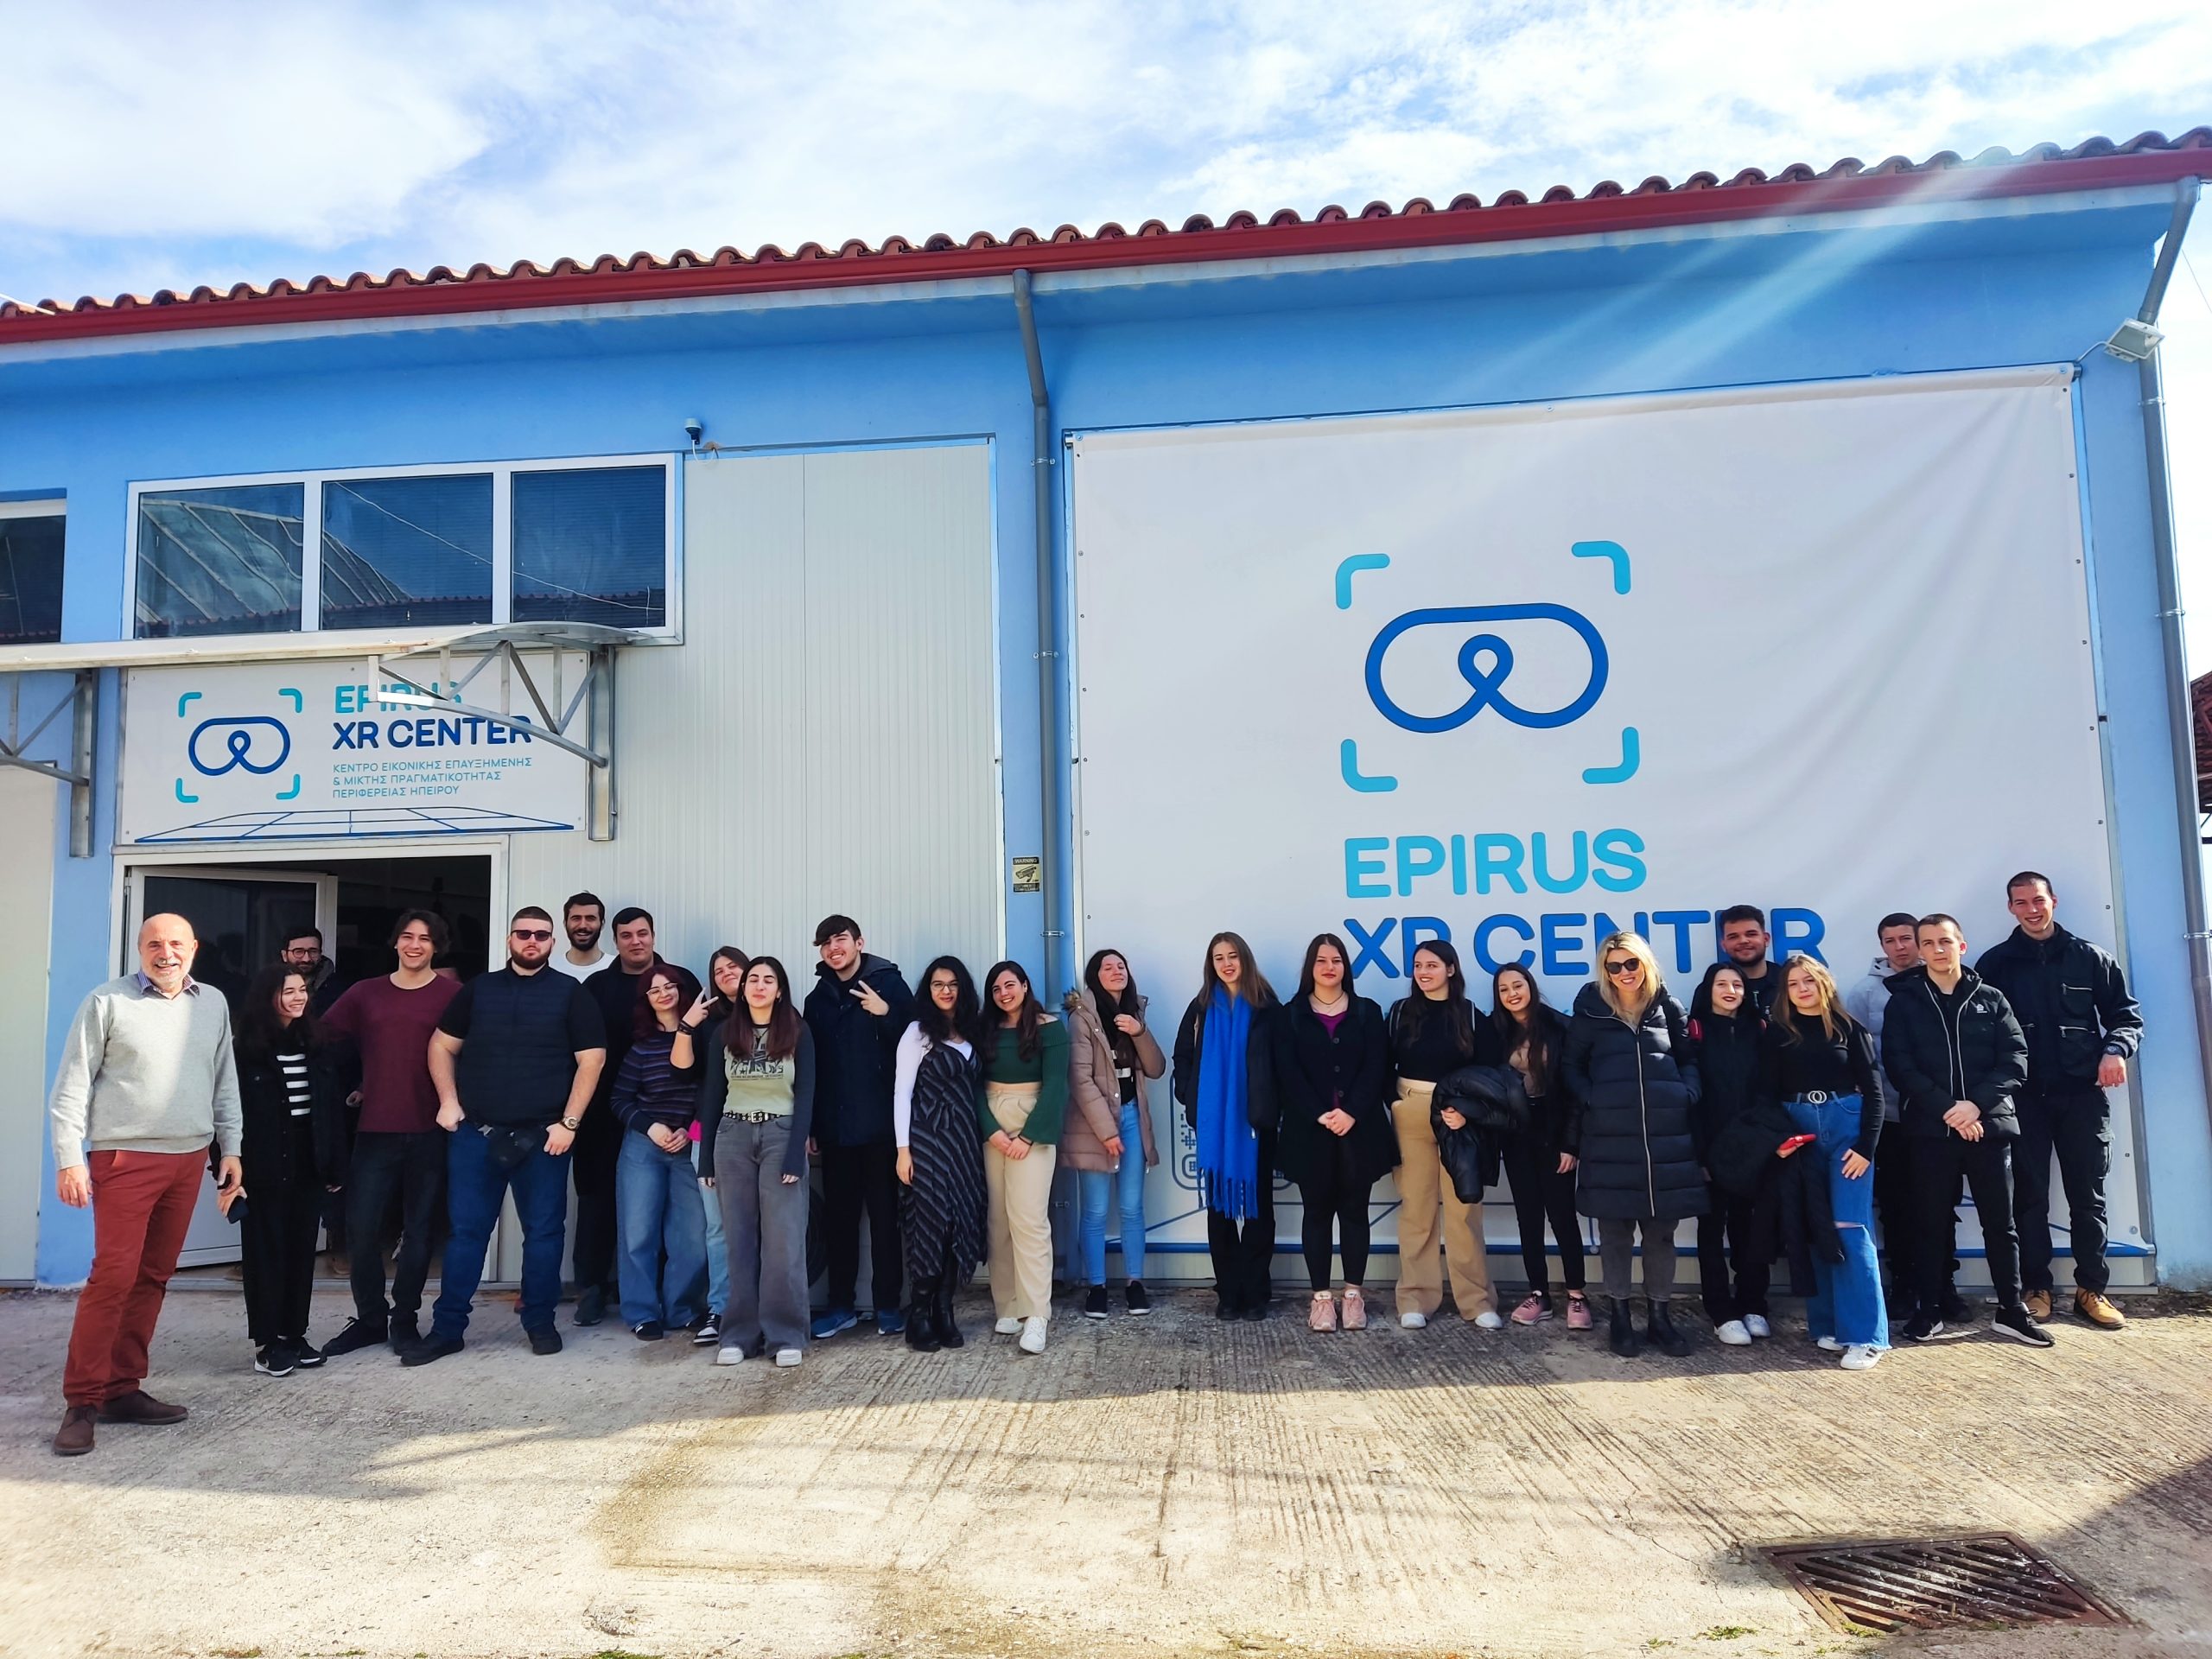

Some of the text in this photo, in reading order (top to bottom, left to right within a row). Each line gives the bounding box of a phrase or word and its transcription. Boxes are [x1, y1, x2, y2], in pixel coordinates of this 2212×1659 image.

[332, 715, 531, 750] XR CENTER
[333, 757, 532, 773] ΚΕΝΤΡΟ ΕΙΚΟΝΙΚΗΣ ΕΠΑΥΞΗΜΕΝΗΣ
[333, 771, 501, 786] & ΜΙΚΤΗΣ ΠΡΑΓΜΑΤΙΚΟΤΗΤΑΣ
[333, 785, 460, 798] ΠΕΡΙΦΕΡΕΙΑΣ ΗΠΕΙΡΟΥ
[1344, 828, 1647, 899] EPIRUS
